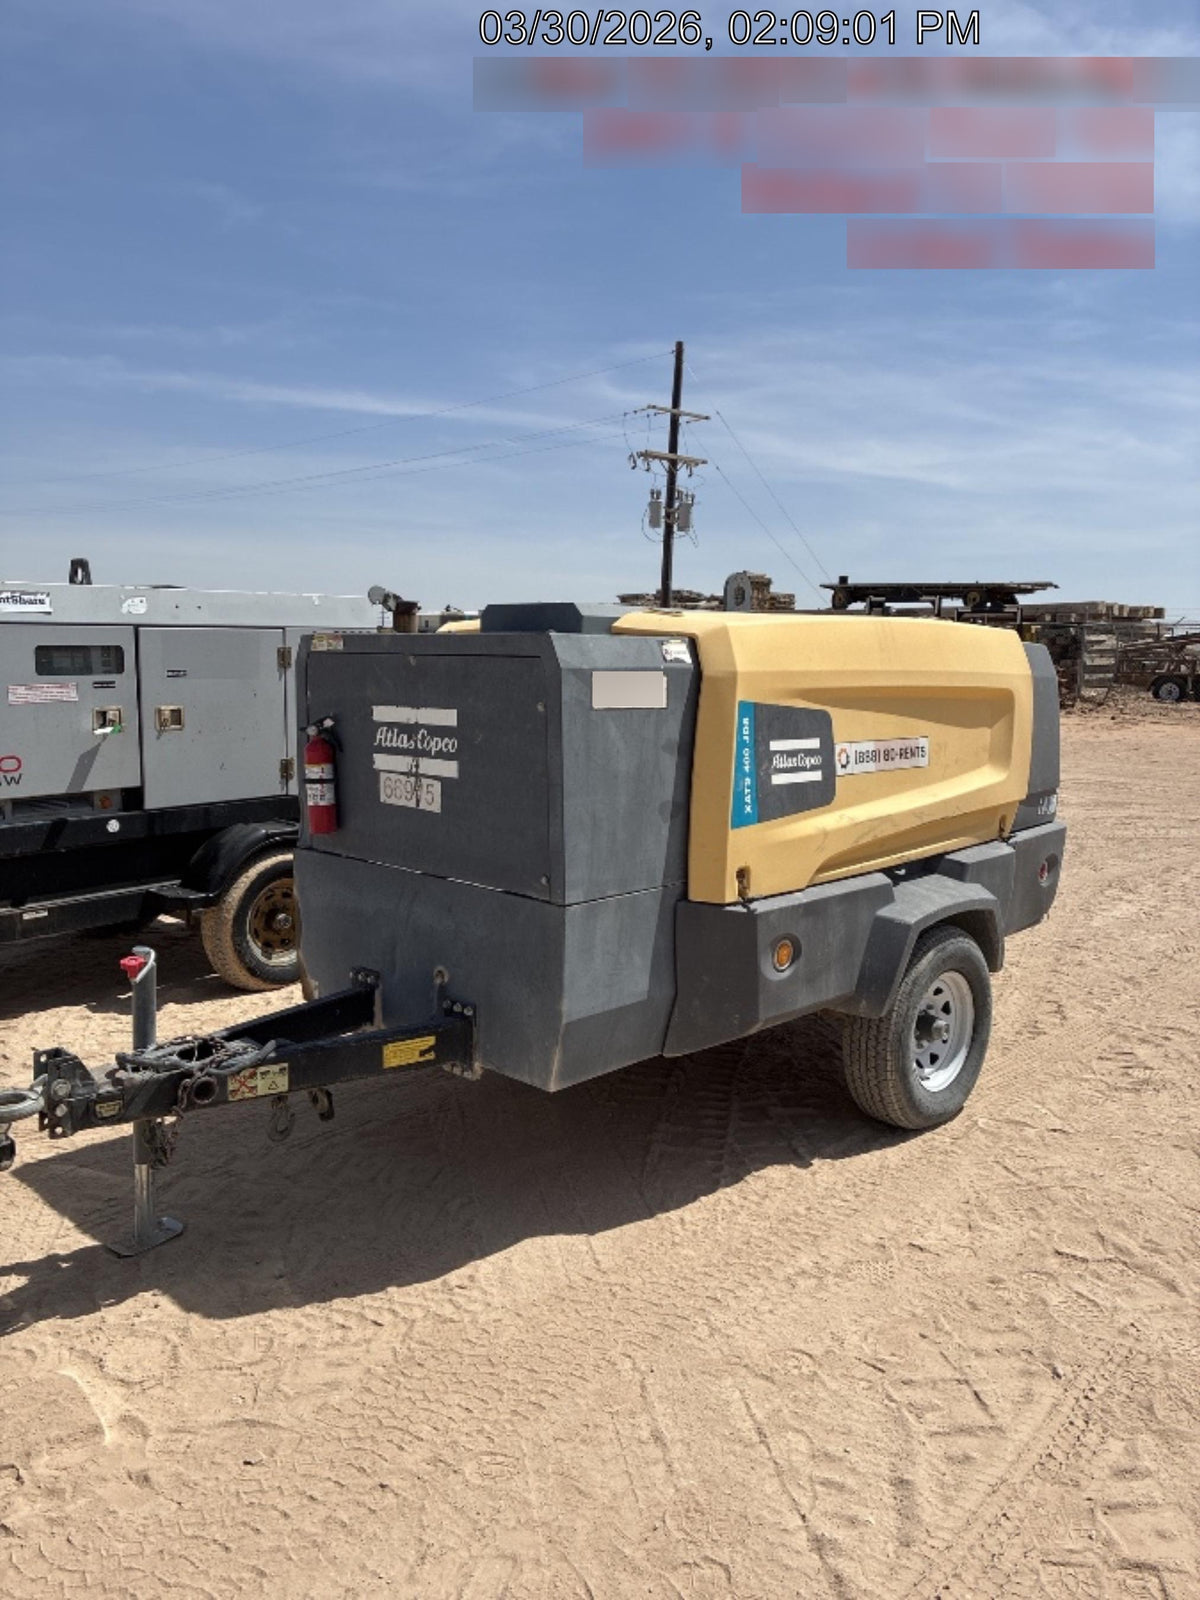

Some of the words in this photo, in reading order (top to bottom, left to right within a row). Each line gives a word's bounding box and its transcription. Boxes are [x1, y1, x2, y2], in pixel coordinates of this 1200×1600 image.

[373, 726, 415, 750] Atlas
[417, 728, 458, 756] Copco
[771, 753, 797, 769] Atlas
[797, 752, 822, 769] Copco
